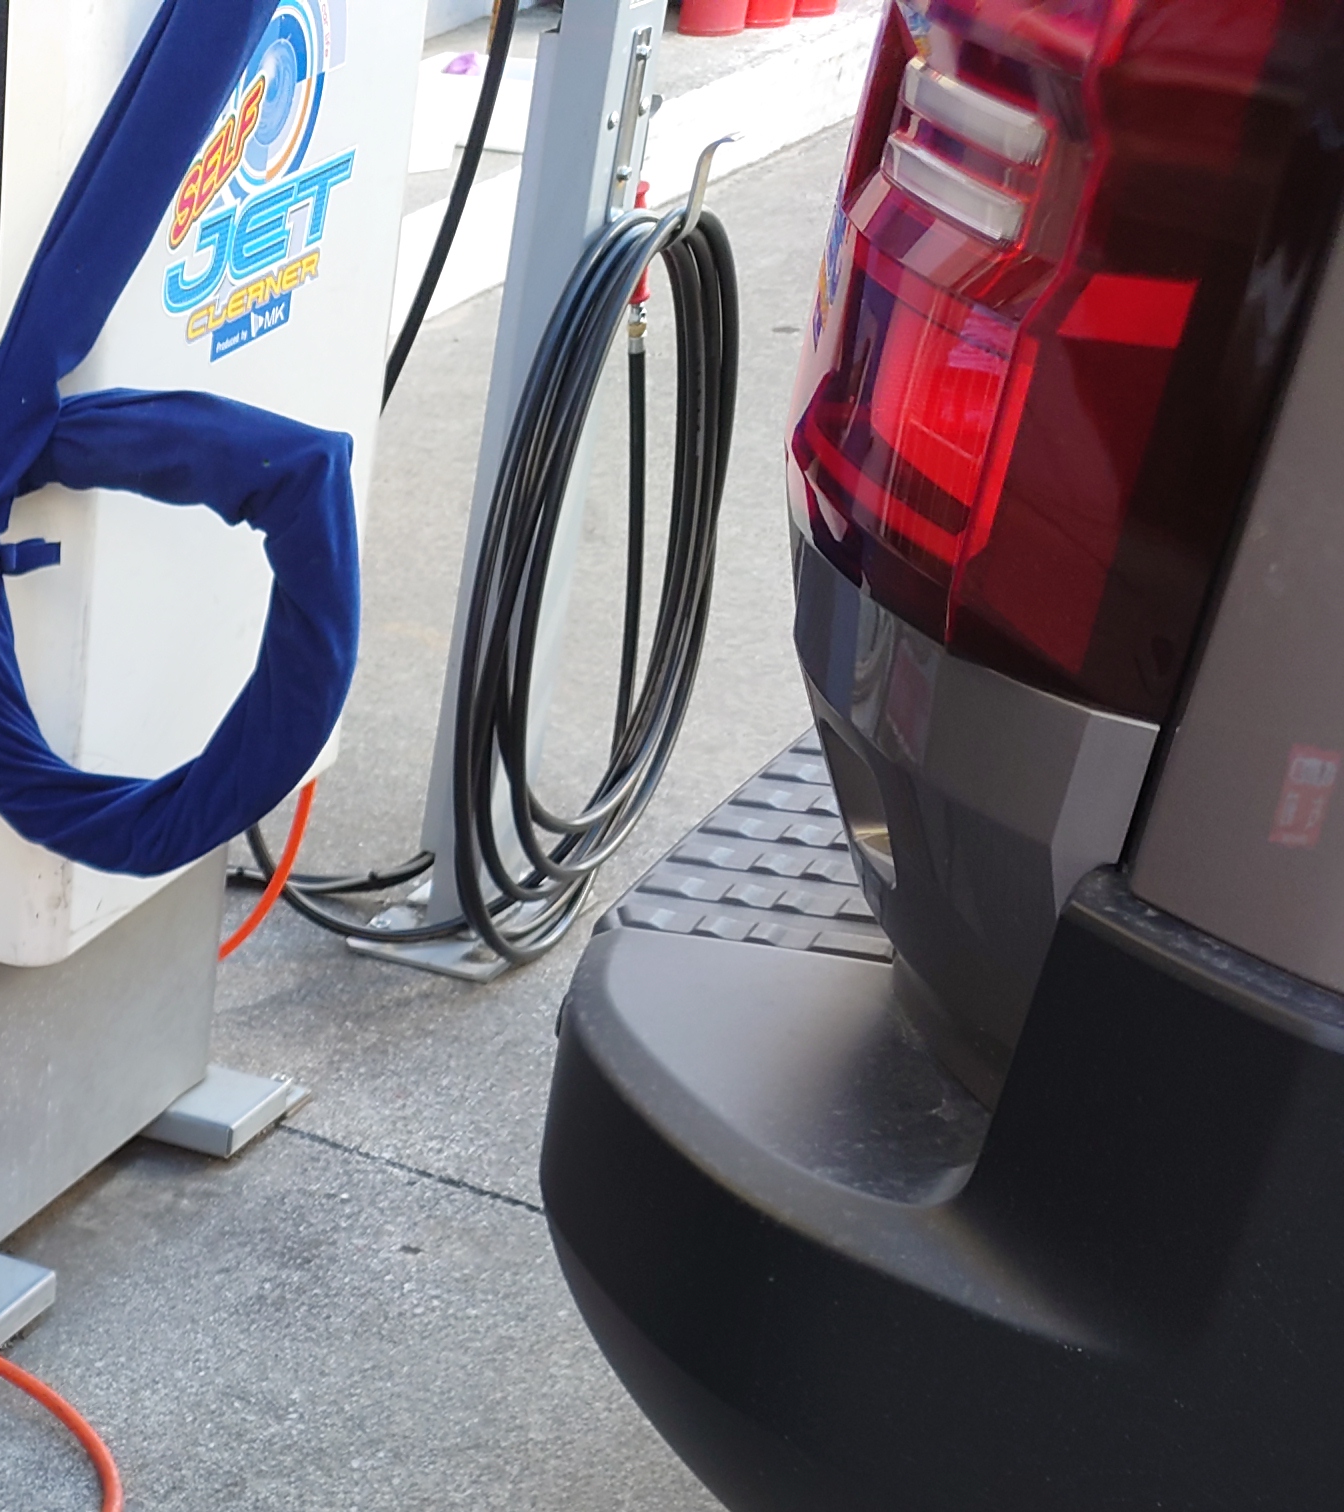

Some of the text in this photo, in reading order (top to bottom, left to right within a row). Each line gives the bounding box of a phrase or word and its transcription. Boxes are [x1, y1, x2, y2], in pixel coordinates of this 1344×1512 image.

[170, 75, 266, 249] SELF
[162, 148, 357, 314] JET
[187, 250, 320, 342] CLEANER
[216, 332, 240, 353] Produced
[241, 329, 248, 341] by
